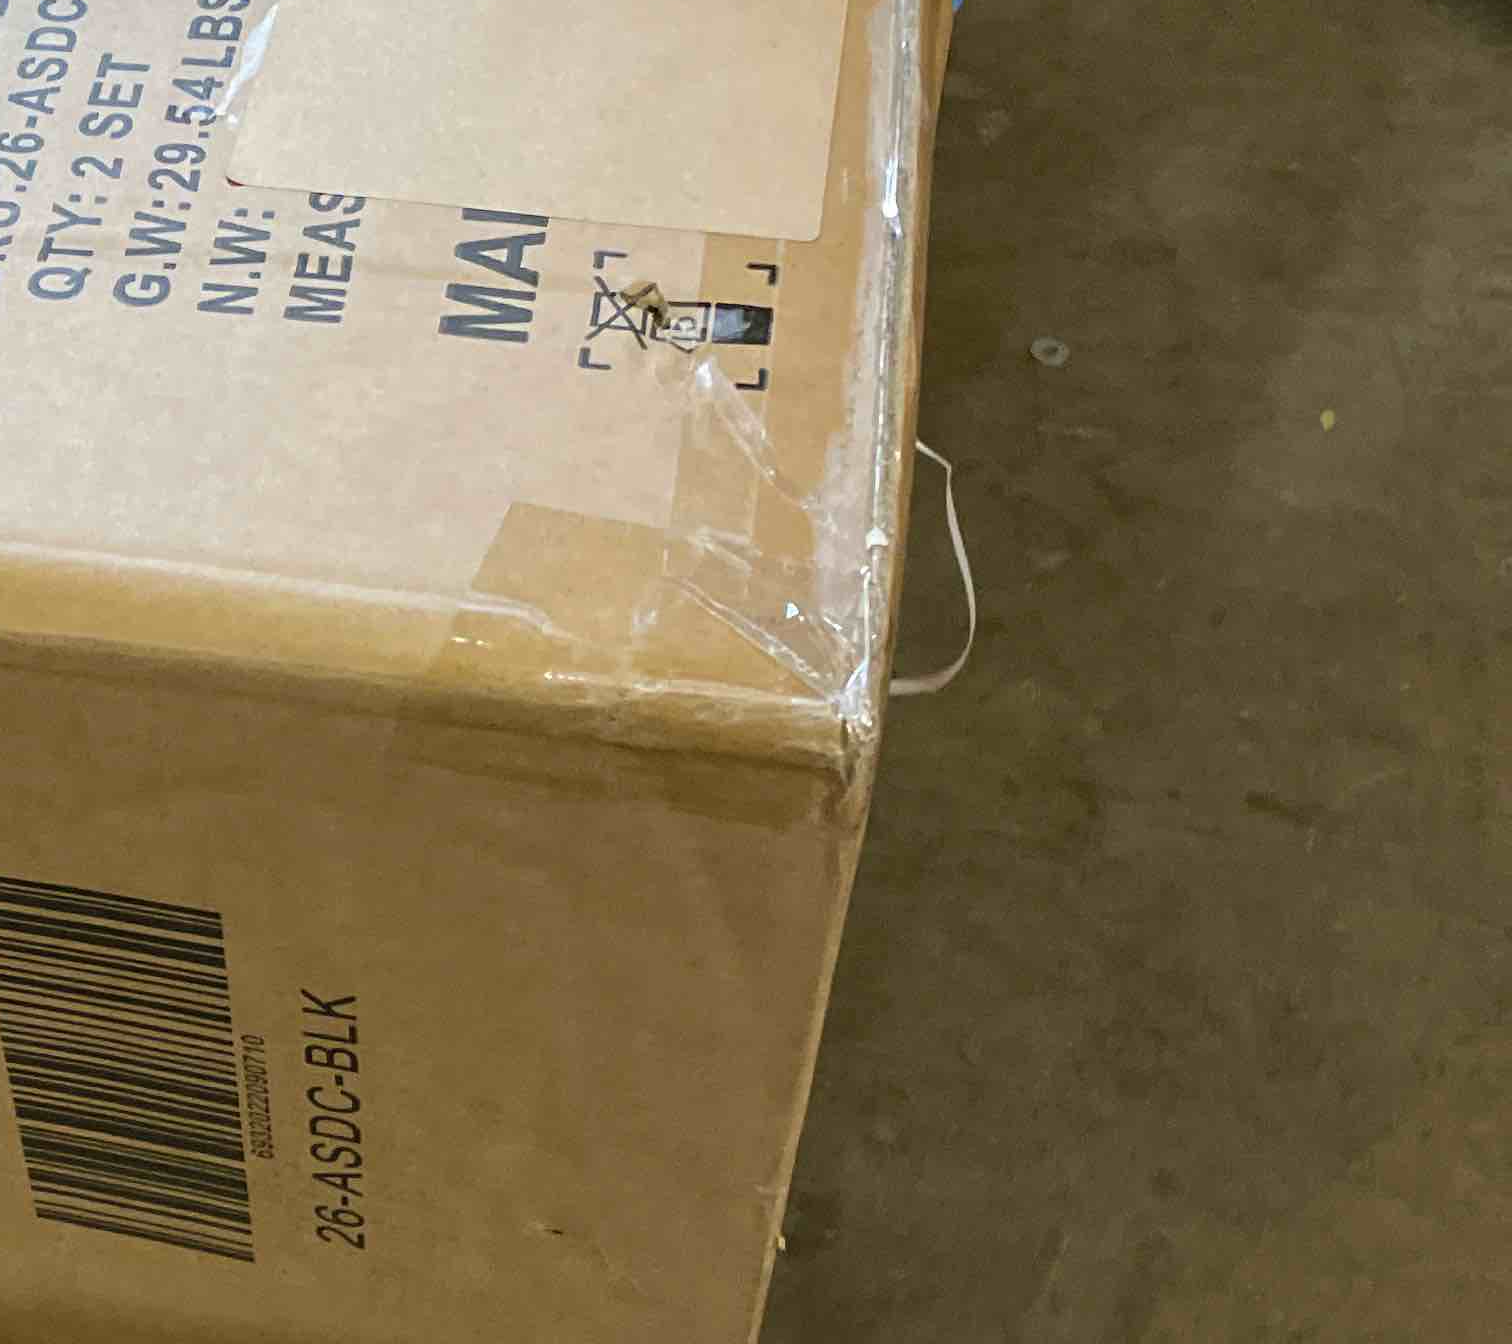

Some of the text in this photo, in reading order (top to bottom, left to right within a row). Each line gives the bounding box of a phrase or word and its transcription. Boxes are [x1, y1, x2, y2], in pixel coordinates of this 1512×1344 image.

[78, 53, 152, 140] SET
[196, 208, 276, 316] N.W:
[299, 988, 367, 1252] 26-ASDC-BLK
